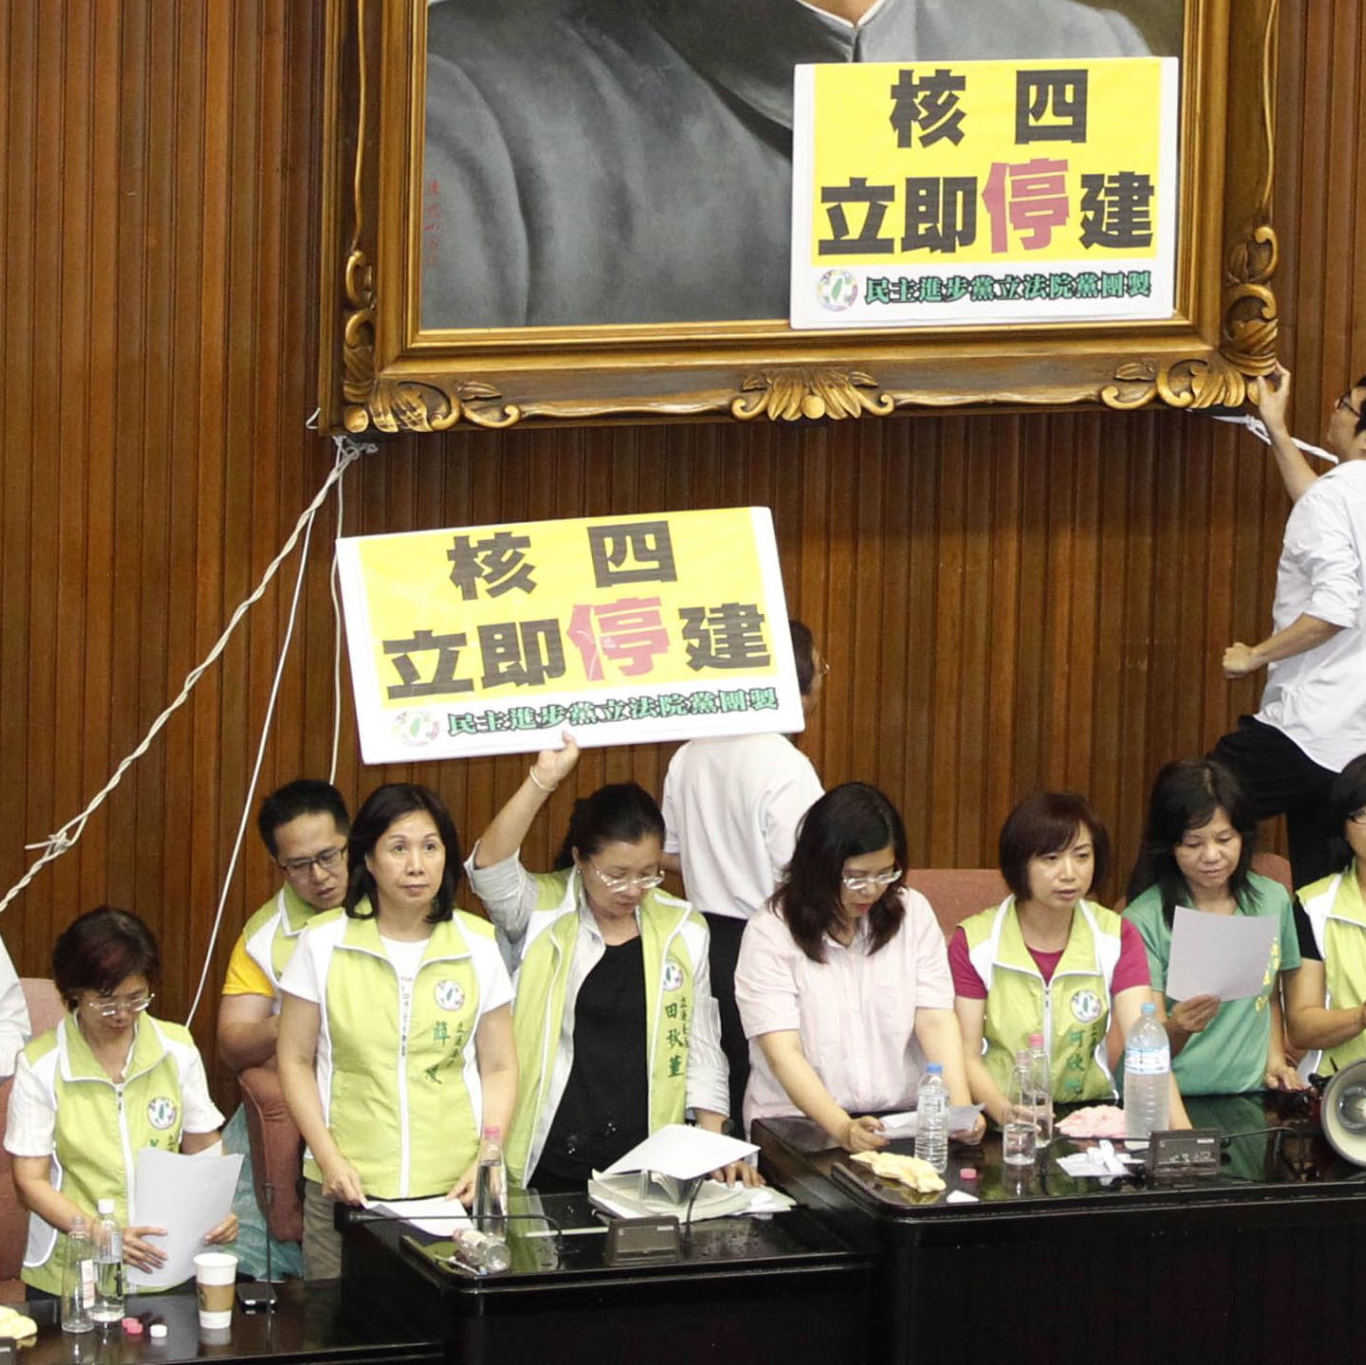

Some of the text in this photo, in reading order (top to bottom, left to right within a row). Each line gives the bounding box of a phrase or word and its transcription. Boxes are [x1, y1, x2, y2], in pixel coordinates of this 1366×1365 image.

[889, 68, 1089, 149] 核四
[818, 157, 1155, 256] 立即停建
[865, 270, 1153, 305] 民主進步黨立法院黨團製
[447, 520, 678, 601] 核四
[382, 597, 772, 700] 立即停建
[448, 687, 779, 737] 民主進步黨立法院黨團製
